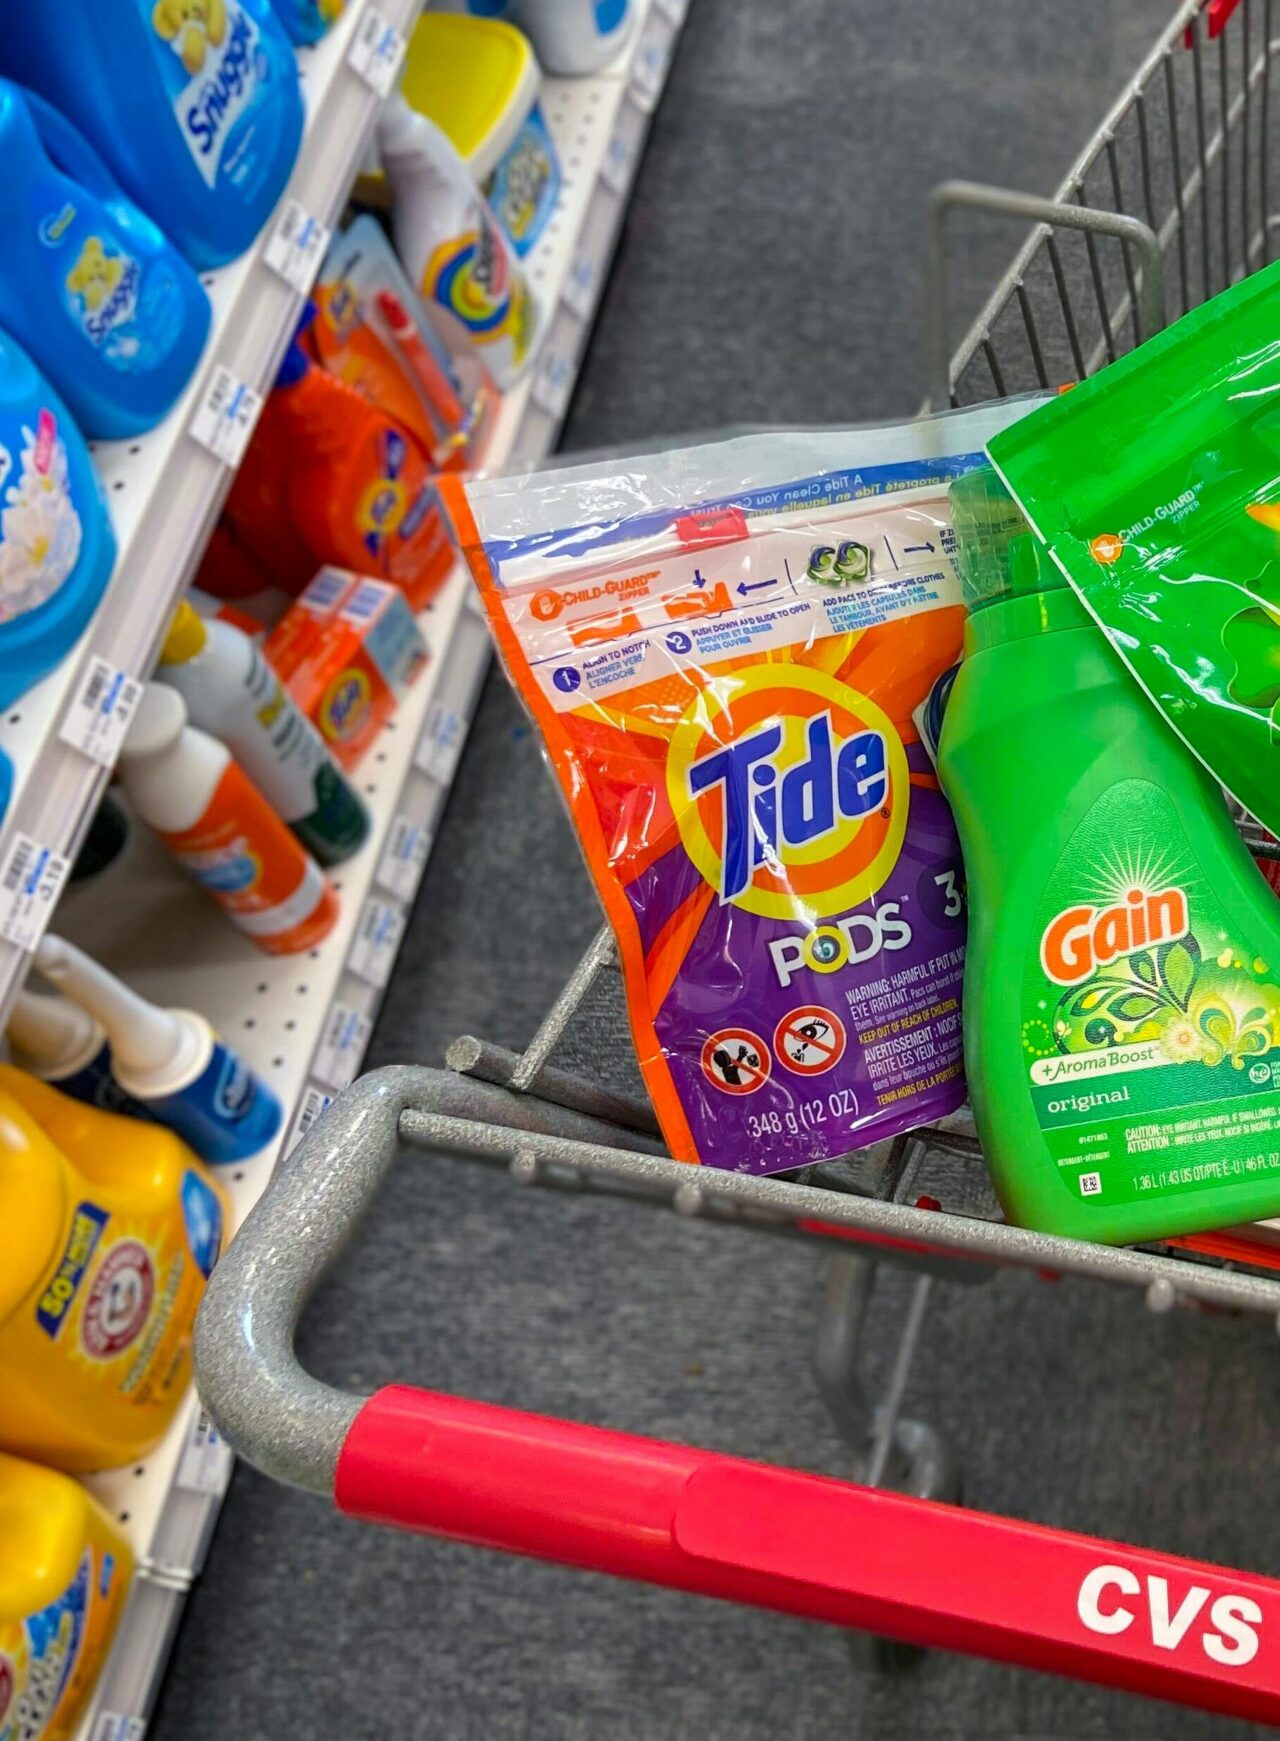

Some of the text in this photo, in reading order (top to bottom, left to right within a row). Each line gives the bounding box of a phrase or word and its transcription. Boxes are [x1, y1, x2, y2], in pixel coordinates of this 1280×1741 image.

[1169, 499, 1202, 523] ZIPPER
[618, 587, 650, 601] ZIPPER
[822, 571, 945, 606] ADD PACS TO CLOTHES
[691, 603, 810, 636] PUSH DOWN TO OPEN
[608, 649, 622, 662] TO
[673, 633, 686, 650] 2
[584, 660, 623, 680] ALIGNER
[689, 706, 887, 904] Tide
[770, 905, 913, 987] PODS
[1042, 888, 1188, 984] Gain
[844, 953, 951, 1004] WARNING: HARMFUL IF PUT
[850, 985, 926, 1020] EYE IRRITANT. Pacs
[854, 1017, 875, 1031] them.
[857, 1024, 893, 1044] KEEP OUT
[861, 1026, 936, 1064] AVERTISSEMENT
[866, 1040, 940, 1079] IRRITE LES YEUX.
[871, 1076, 890, 1091] dans
[875, 1078, 928, 1106] TENIR DE
[750, 1086, 860, 1139] 348 g (12 OZ)
[1046, 1085, 1131, 1116] original
[1124, 1123, 1163, 1142] CAUTION:
[1126, 1135, 1170, 1154] ATTENTION
[1132, 1151, 1280, 1191] 1.36 (1.43 US 46 OZ
[1077, 1564, 1263, 1667] CVS
